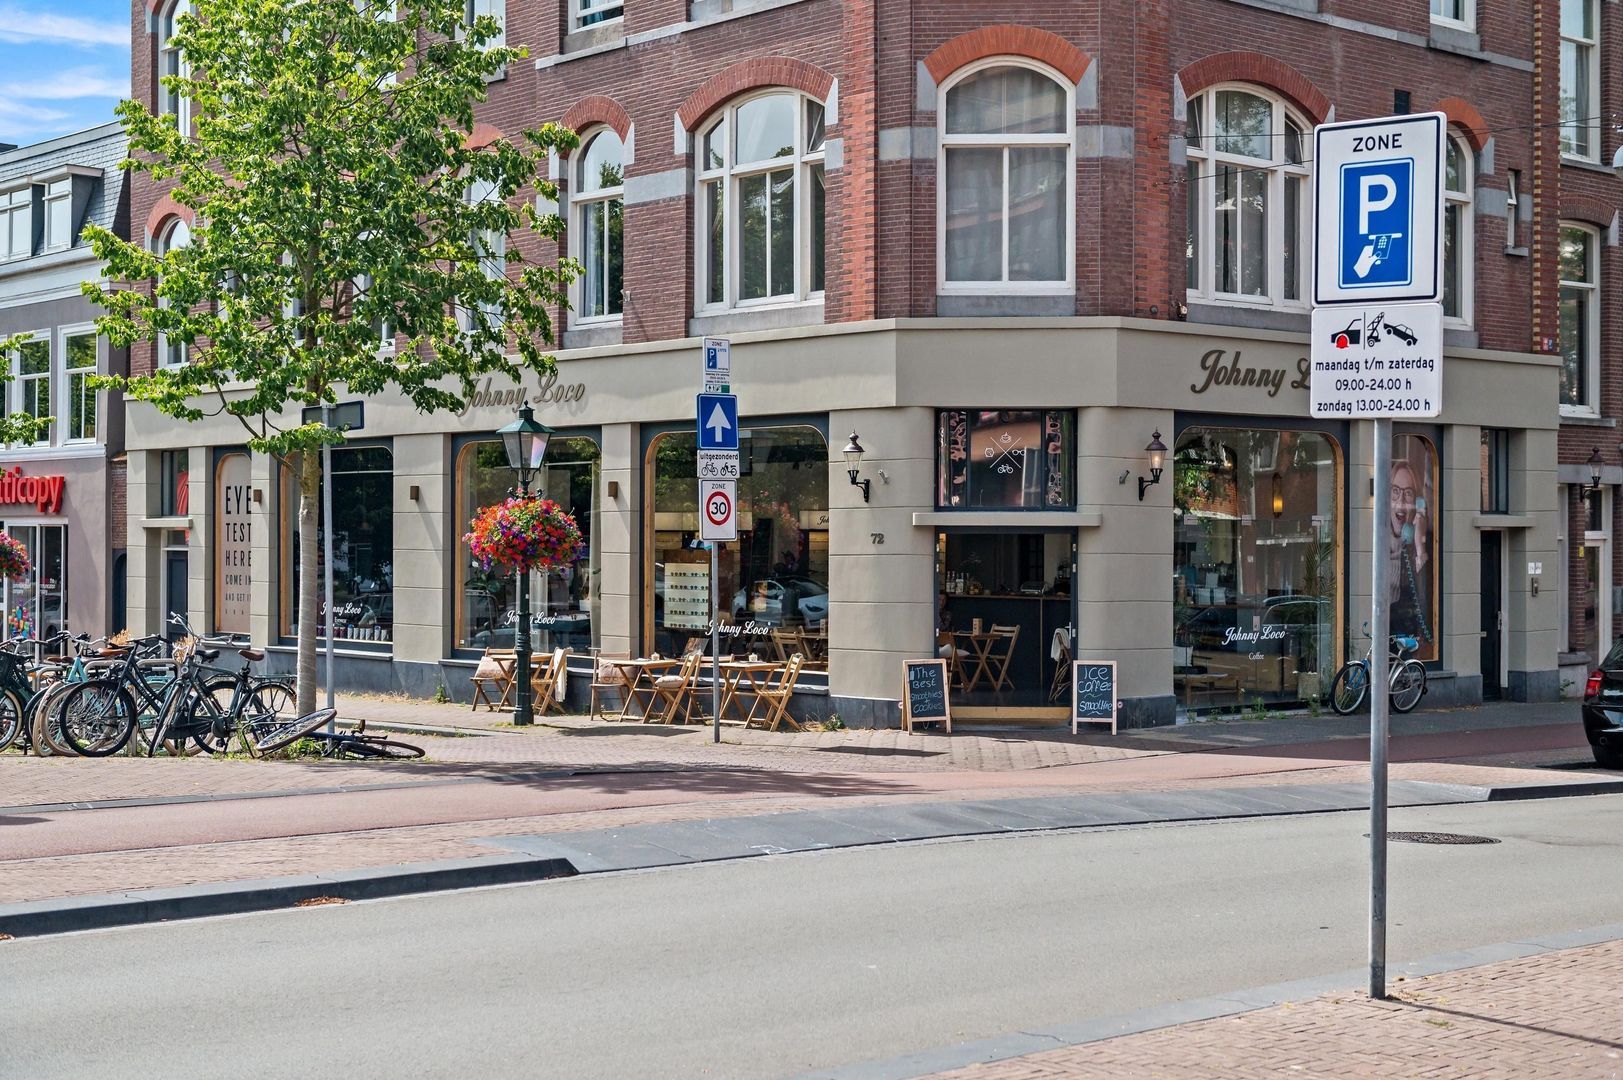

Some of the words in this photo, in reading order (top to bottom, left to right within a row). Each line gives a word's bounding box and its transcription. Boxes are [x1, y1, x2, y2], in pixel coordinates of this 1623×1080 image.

[1353, 133, 1402, 152] ZONE
[1359, 174, 1397, 234] P
[1315, 358, 1360, 373] maandag
[1364, 357, 1384, 370] t/m
[1388, 356, 1434, 372] zaterdag
[1190, 349, 1287, 397] Johnny
[1335, 378, 1401, 391] 09.00-24.00
[1405, 378, 1412, 390] h
[455, 376, 527, 418] Johnny
[533, 374, 586, 404] Loco
[1317, 400, 1352, 415] zondag
[1356, 399, 1420, 411] 13.00-24.00
[1424, 399, 1431, 411] h
[700, 452, 738, 461] uitgezonderd
[0, 465, 64, 513] ticopy
[225, 486, 252, 514] EYE
[711, 501, 727, 515] 30
[225, 522, 252, 543] TEST
[870, 532, 885, 545] 72
[225, 550, 252, 567] HERE
[225, 574, 242, 586] COME
[320, 601, 345, 616] Jnny
[344, 602, 362, 615] Loco
[534, 611, 556, 625] Loco
[705, 619, 742, 638] Jhnny
[742, 620, 769, 635] Loco
[1221, 626, 1260, 646] Johnny
[1260, 625, 1286, 640] Loco
[1248, 651, 1265, 660] Coffee
[914, 666, 937, 679] The
[912, 678, 937, 689] Best
